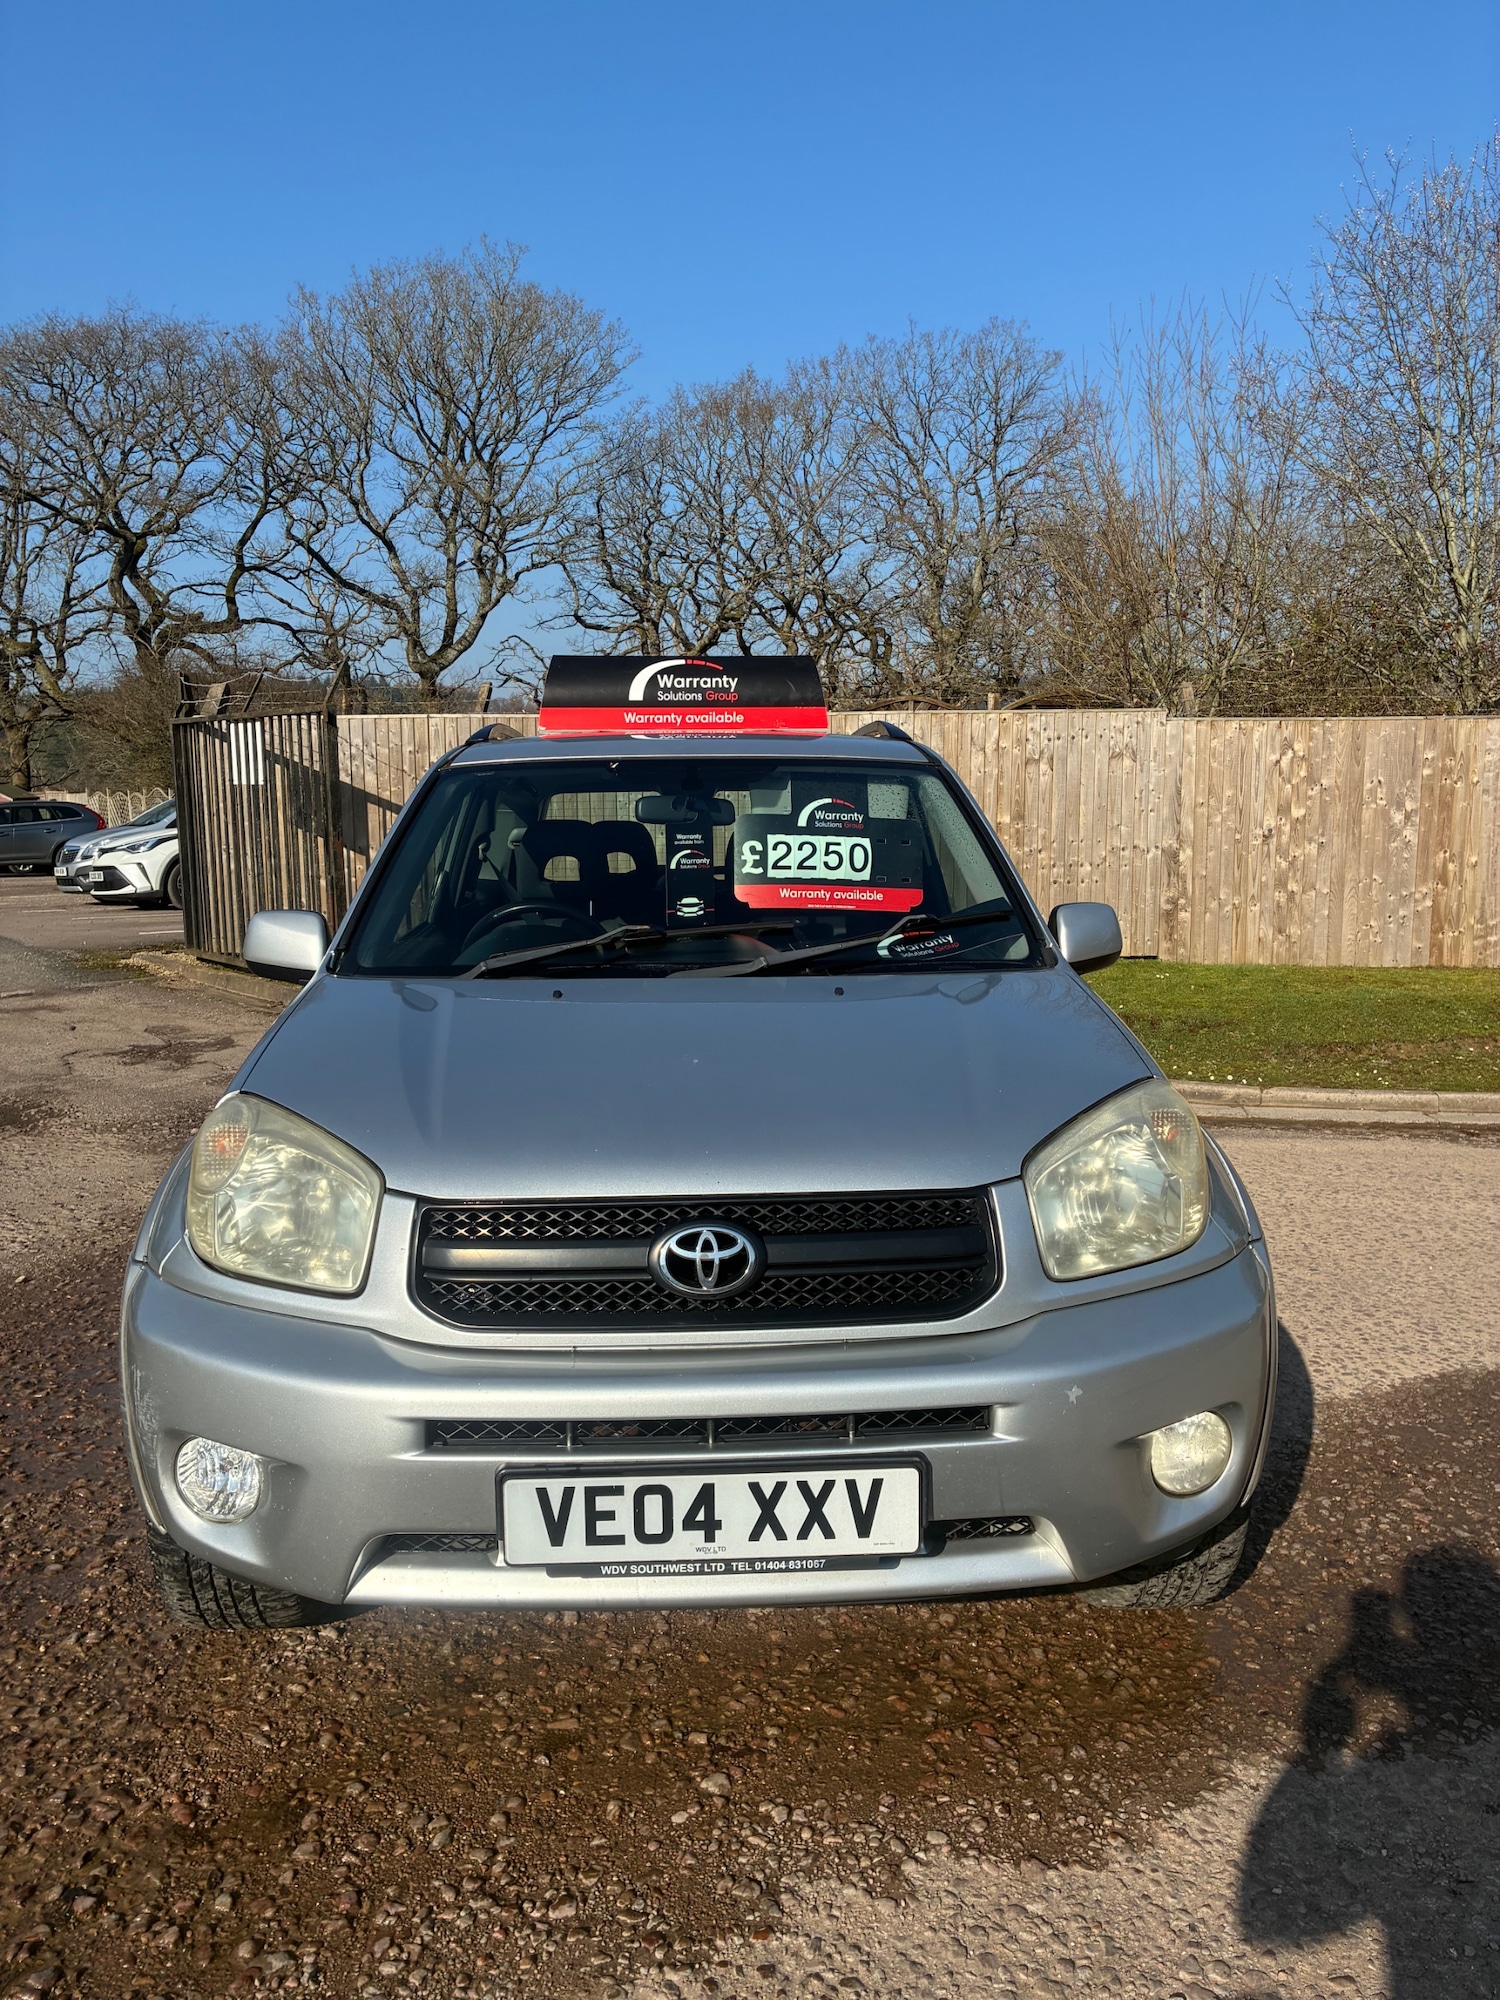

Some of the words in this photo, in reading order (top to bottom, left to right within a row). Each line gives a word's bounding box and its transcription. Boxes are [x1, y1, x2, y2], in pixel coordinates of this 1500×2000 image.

[657, 674, 738, 692] Warranty
[657, 691, 702, 701] Solutions
[705, 691, 738, 703] Group
[624, 712, 682, 726] Warranty
[685, 711, 744, 723] available
[814, 810, 864, 824] Warranty
[844, 821, 864, 829] Group
[680, 857, 710, 865] Warranty
[741, 840, 870, 874] £2250
[779, 888, 831, 902] Warranty
[833, 889, 884, 901] available
[891, 934, 954, 953] Warranty
[933, 942, 960, 953] Group
[535, 1482, 722, 1547] VE04
[747, 1477, 884, 1542] XXV
[600, 1565, 627, 1574] WDV
[630, 1563, 701, 1574] SOUTHWEST
[704, 1562, 726, 1572] LTD
[731, 1561, 753, 1571] TEL
[754, 1560, 786, 1571] 01404
[788, 1559, 826, 1569] 831067
